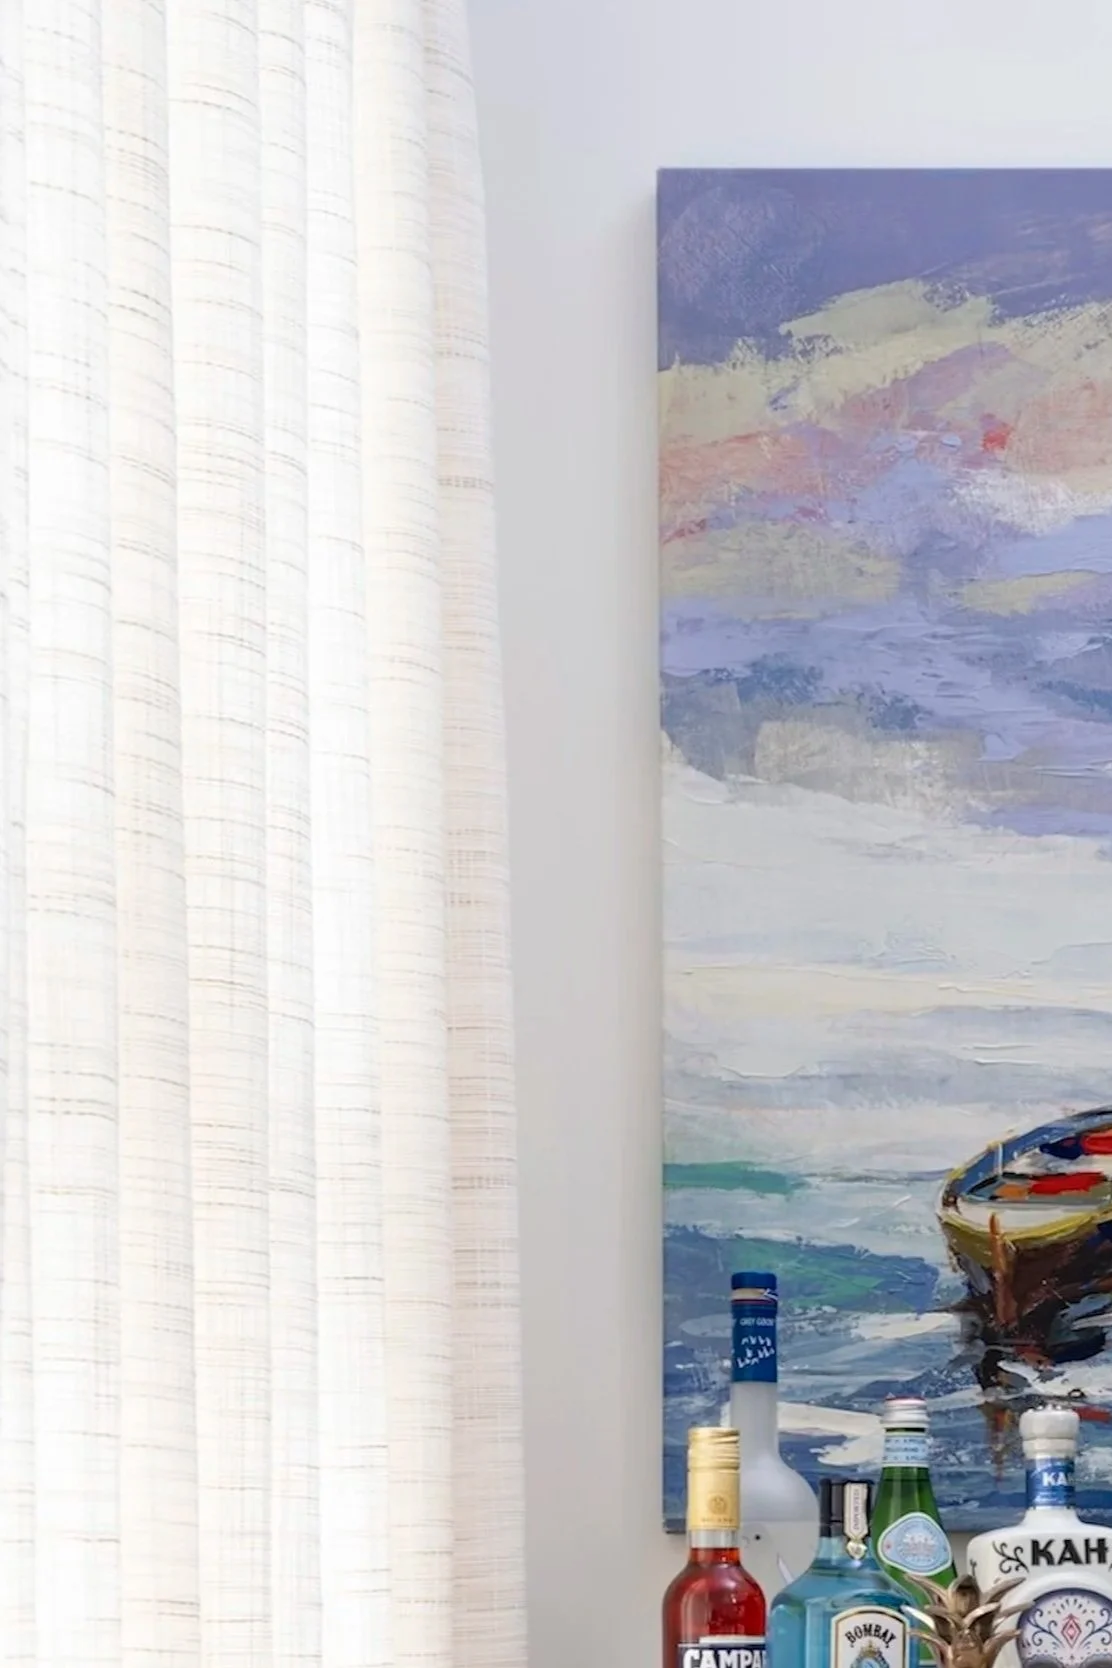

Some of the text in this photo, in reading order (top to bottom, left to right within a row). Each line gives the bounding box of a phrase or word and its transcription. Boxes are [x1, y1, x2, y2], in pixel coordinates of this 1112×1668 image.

[1042, 1471, 1069, 1487] KA
[1030, 1537, 1108, 1566] KAH
[844, 1623, 897, 1648] BOMBAY
